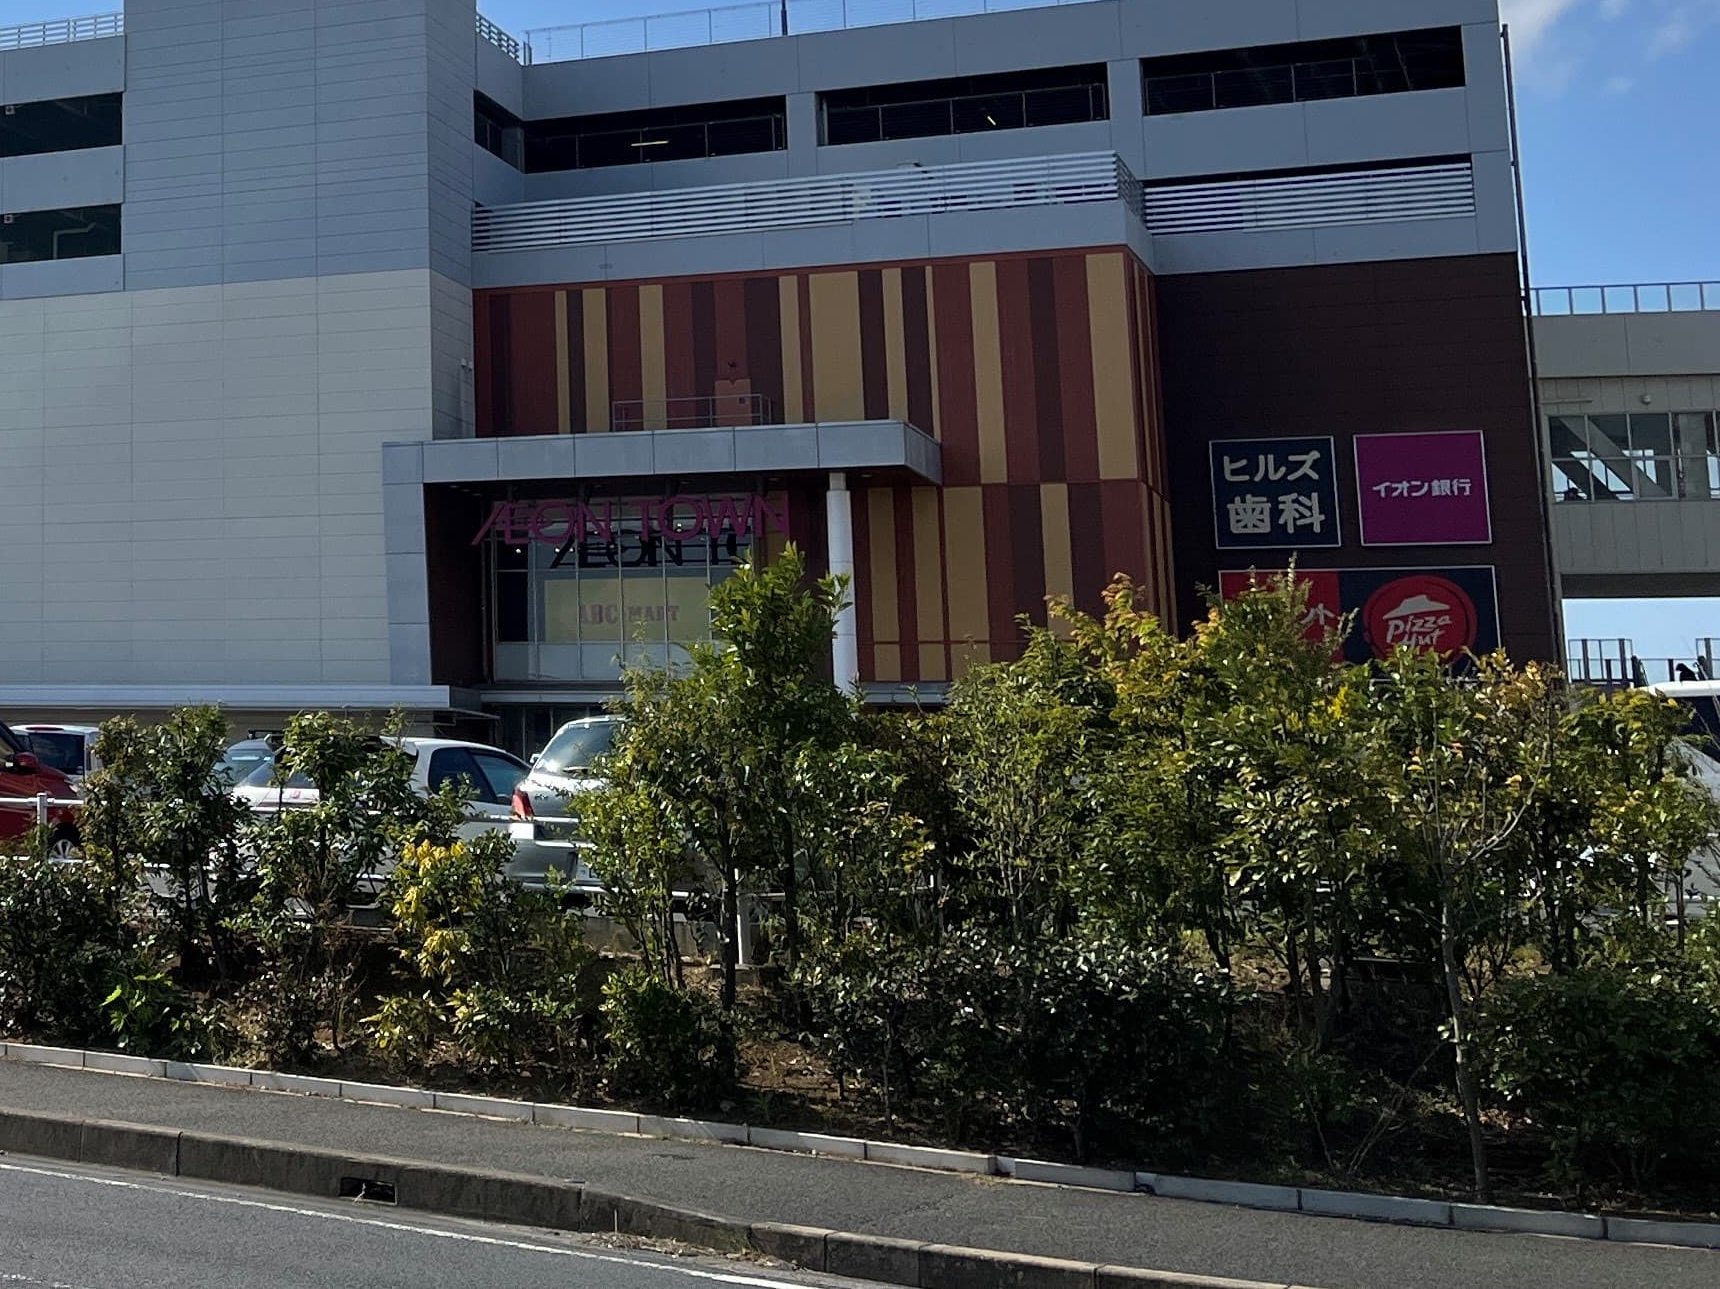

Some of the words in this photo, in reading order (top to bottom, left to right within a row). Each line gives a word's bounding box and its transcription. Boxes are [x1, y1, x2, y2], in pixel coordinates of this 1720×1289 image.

[1223, 450, 1321, 482] ヒルズ
[1372, 477, 1473, 498] イオン銀行
[633, 491, 791, 542] TOWN
[1227, 492, 1326, 534] 歯科
[1386, 613, 1453, 645] Pizza
